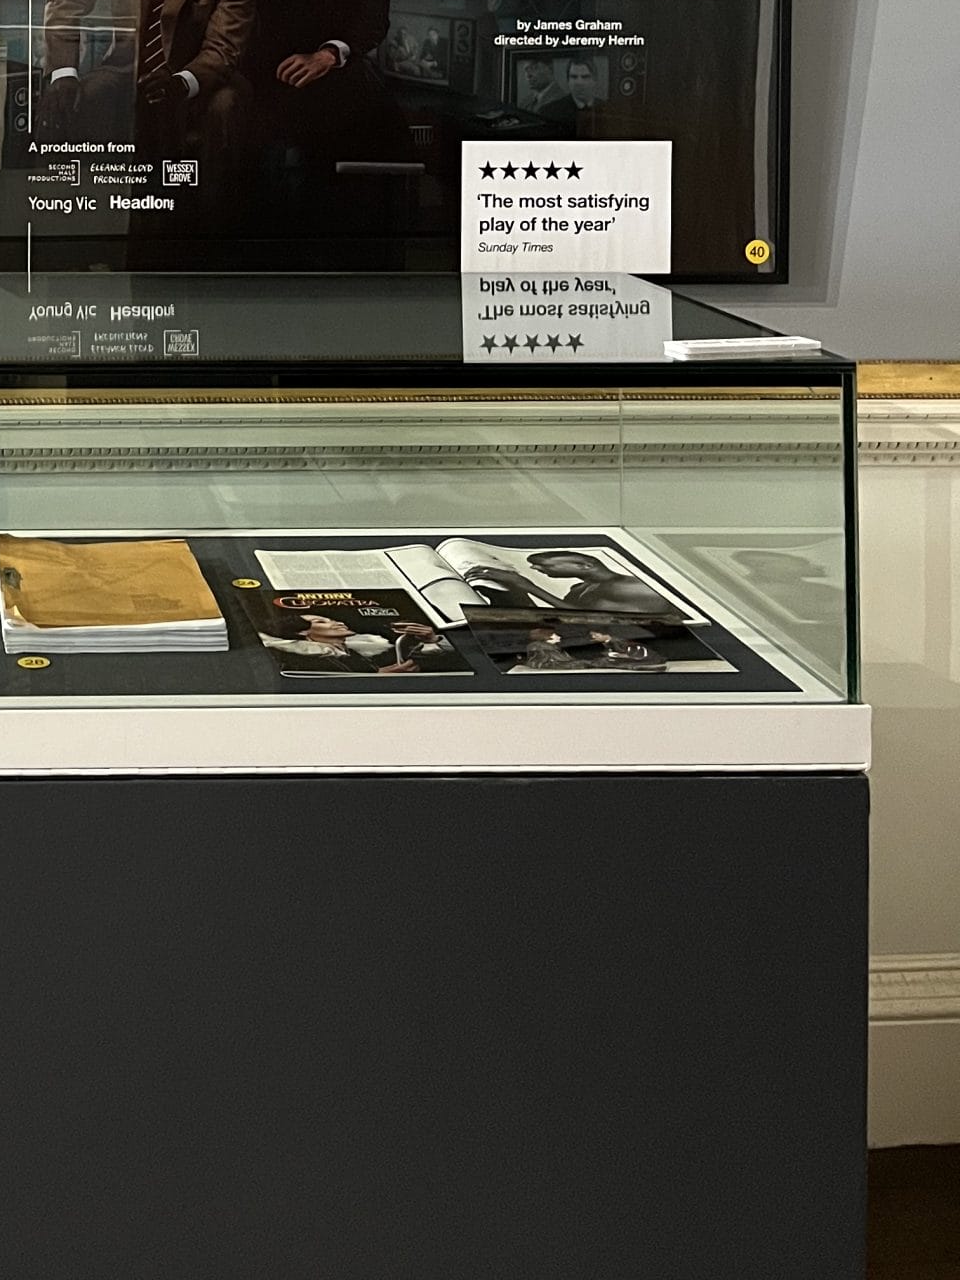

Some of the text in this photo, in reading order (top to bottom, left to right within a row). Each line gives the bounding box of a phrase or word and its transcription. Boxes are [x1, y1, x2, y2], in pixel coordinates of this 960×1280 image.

[516, 19, 622, 33] by James Graham
[494, 34, 645, 49] directed by Jeremy Herrin
[28, 141, 136, 155] A production from
[90, 163, 154, 173] ELEANOR LLOYD
[166, 163, 195, 173] WESSEX
[28, 175, 76, 183] PRODUCTIONS
[93, 175, 148, 185] PRODUCTIONS
[168, 173, 192, 183] GROVE
[28, 195, 97, 214] Young Vic
[518, 194, 562, 209] most
[567, 193, 650, 212] satisfying
[479, 216, 515, 235] play
[519, 216, 538, 232] of
[541, 216, 569, 232] the
[478, 241, 554, 254] Sunday Times
[749, 245, 766, 258] 40
[296, 592, 352, 600] ANTONY
